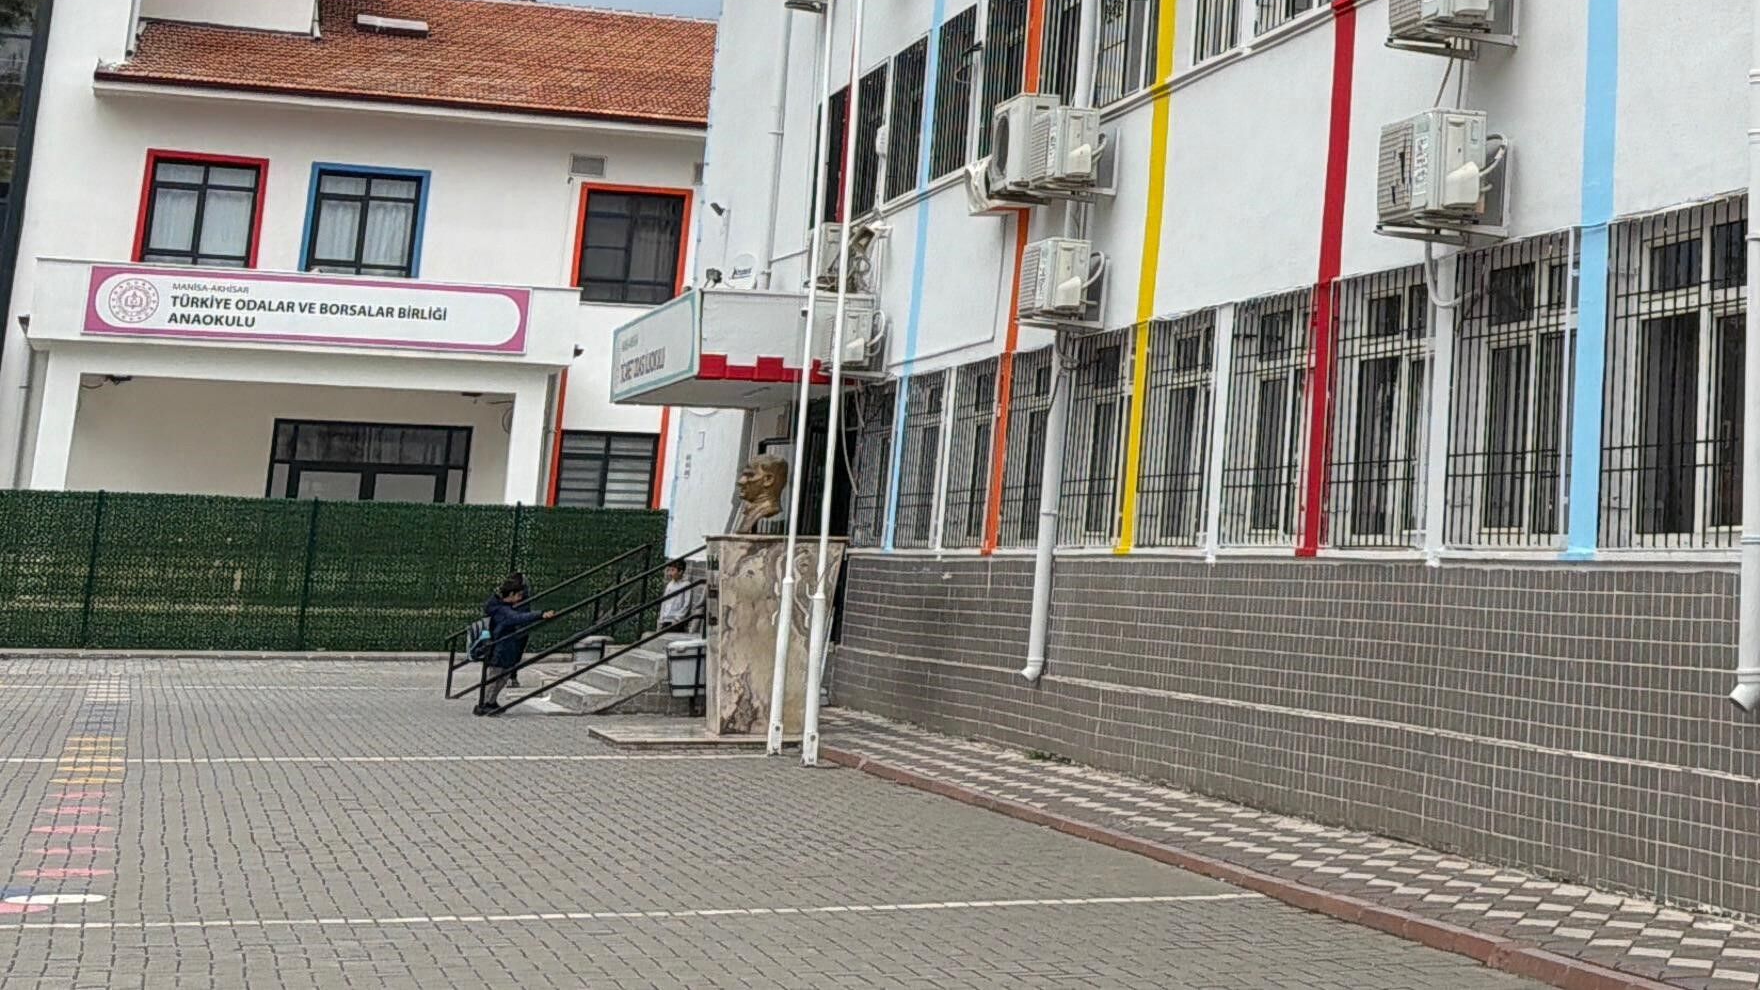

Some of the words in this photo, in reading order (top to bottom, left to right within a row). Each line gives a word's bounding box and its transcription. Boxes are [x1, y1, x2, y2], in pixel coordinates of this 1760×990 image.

[171, 294, 232, 310] TÜRKİYE
[235, 299, 295, 313] ODALAR
[299, 302, 316, 314] VE
[320, 303, 395, 318] BORSALAR
[398, 304, 448, 321] BİRLİĞİ
[168, 313, 256, 328] ANAOKULU
